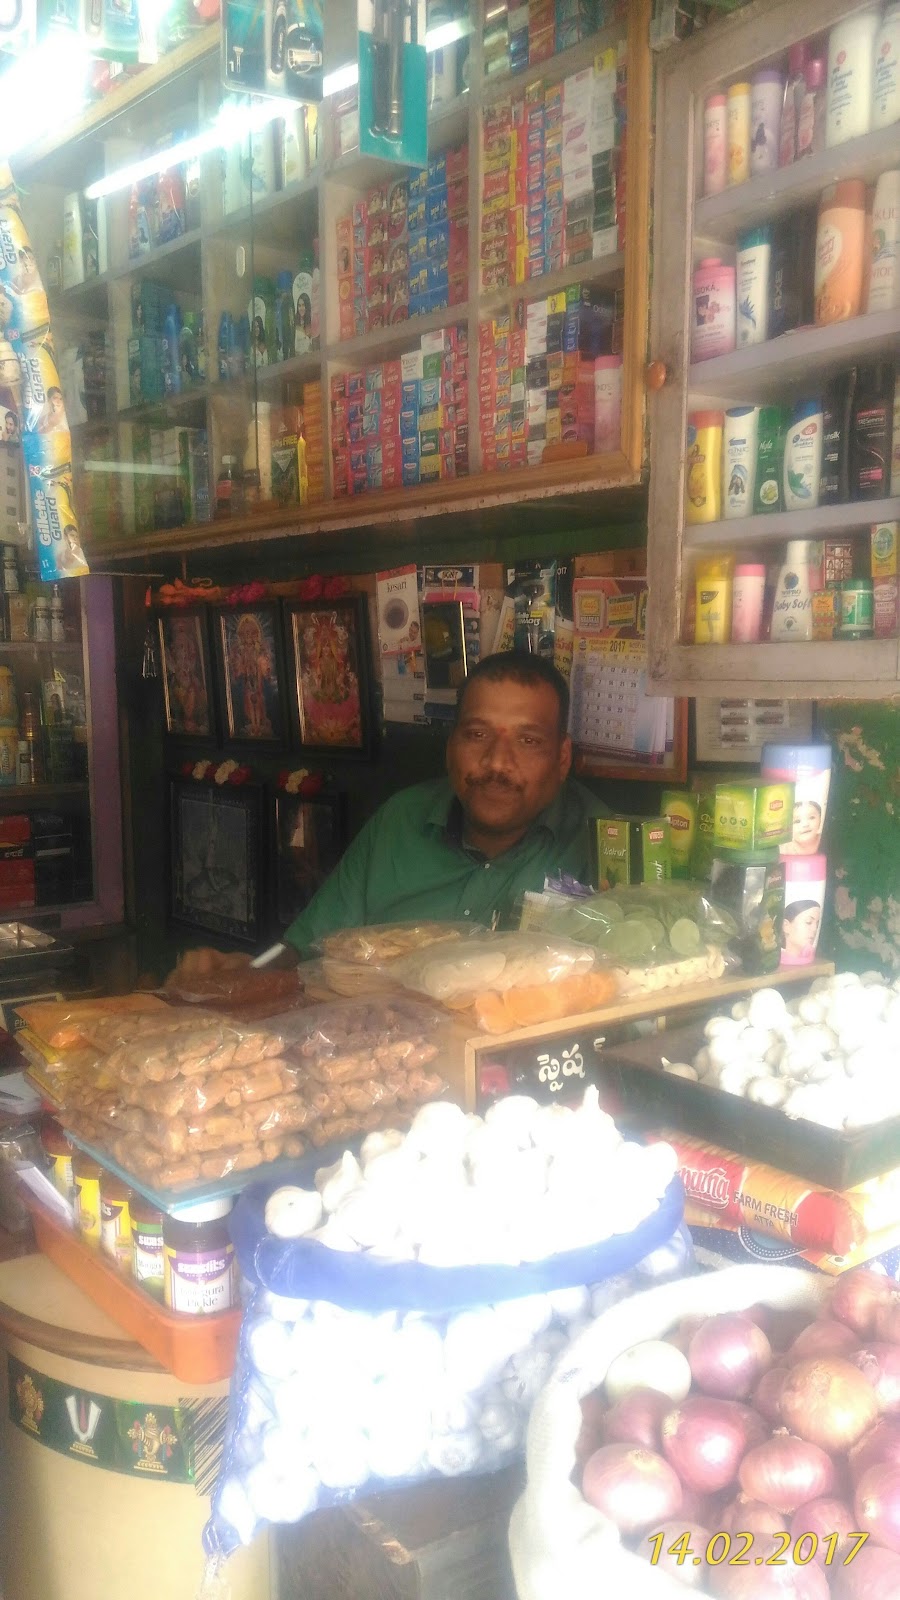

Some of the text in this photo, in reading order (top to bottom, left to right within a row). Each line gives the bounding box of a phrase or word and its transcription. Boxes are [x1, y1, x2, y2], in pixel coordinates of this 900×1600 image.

[34, 489, 52, 546] Gillette
[46, 497, 62, 541] Guard
[610, 641, 626, 653] 2017
[671, 816, 688, 828] ipton
[678, 1165, 730, 1201] purna
[733, 1190, 798, 1227] FARM FRESH
[753, 1214, 774, 1227] ATTA
